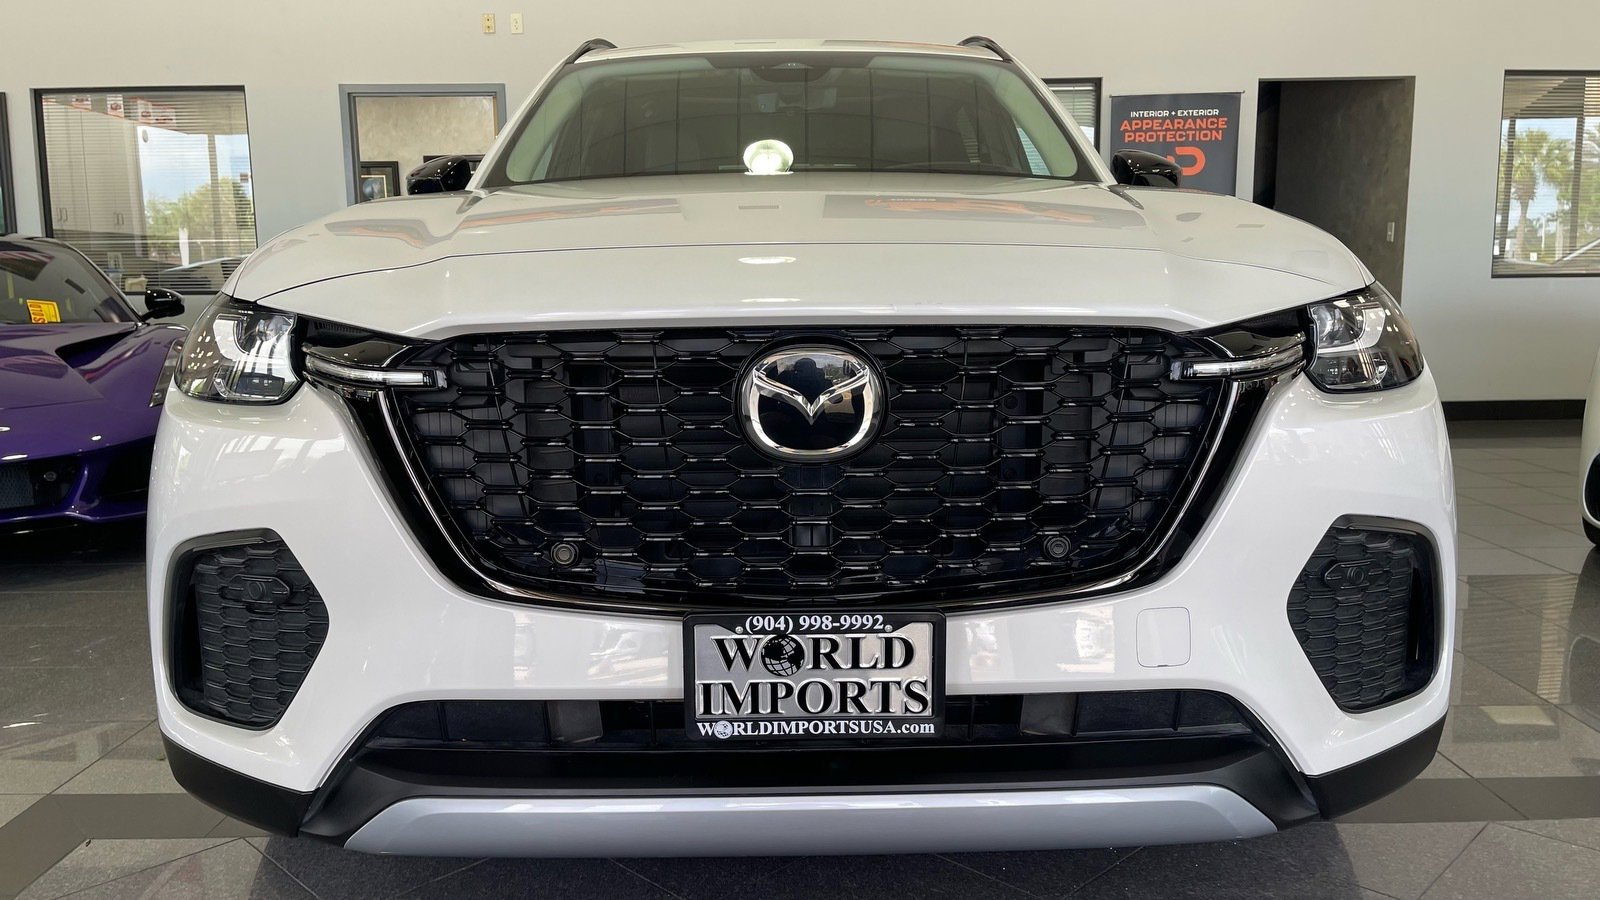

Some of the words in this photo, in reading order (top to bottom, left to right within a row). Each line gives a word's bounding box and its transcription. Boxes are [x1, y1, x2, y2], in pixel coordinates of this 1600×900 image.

[1130, 110, 1169, 118] INTERIOR
[1177, 109, 1220, 117] EXTERIOR
[1120, 117, 1228, 131] APPEARANCE
[1124, 130, 1223, 143] PROTECTION
[745, 615, 794, 634] (904)
[799, 614, 884, 631] 998-9992
[696, 677, 932, 716] IMPORTS
